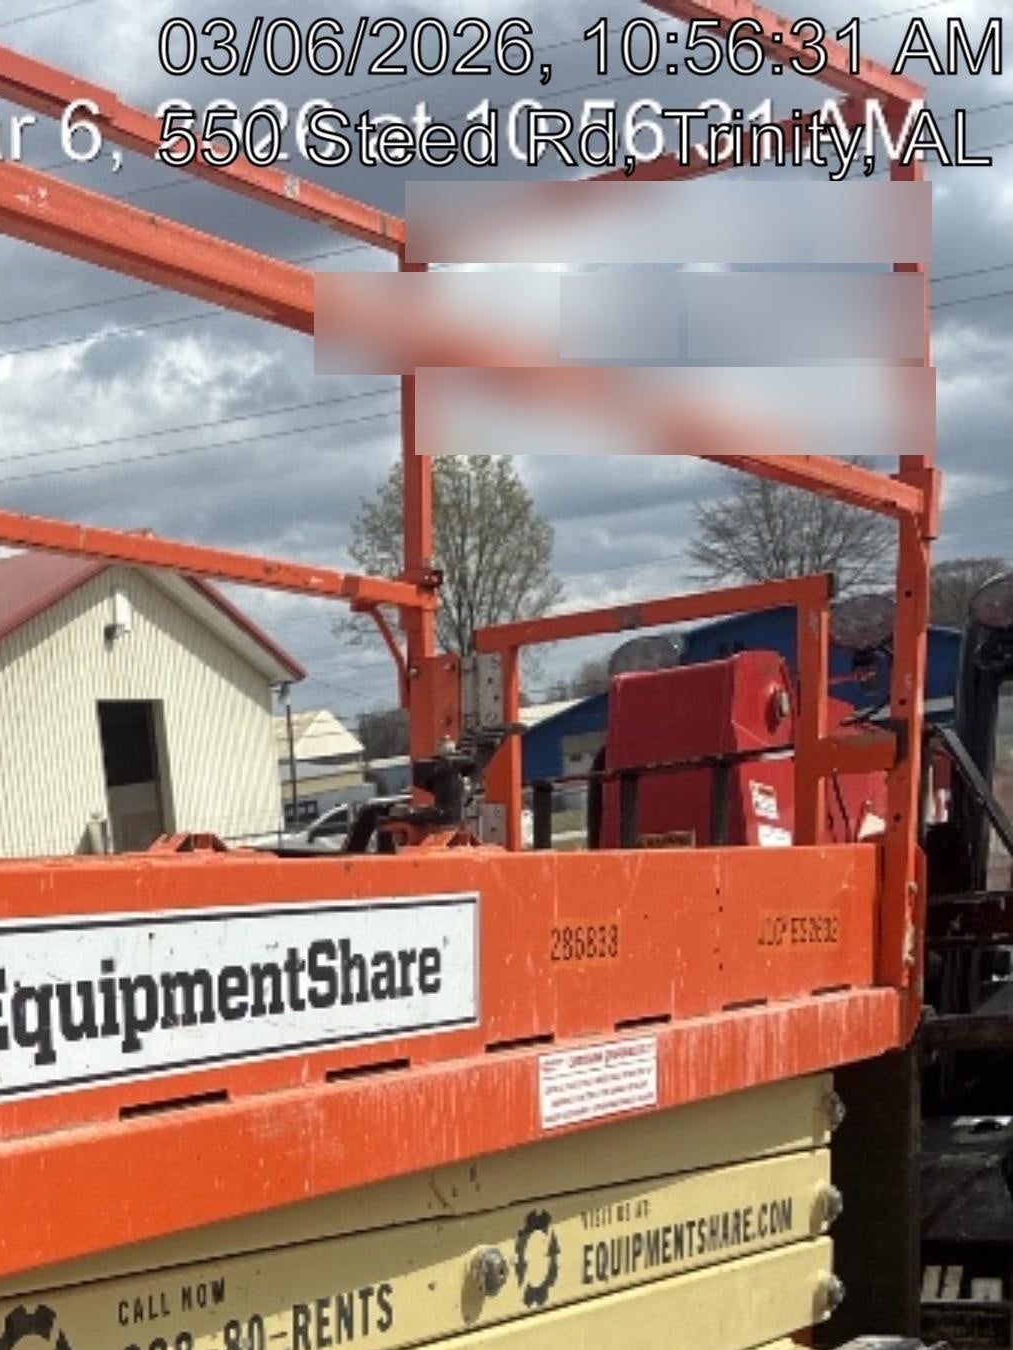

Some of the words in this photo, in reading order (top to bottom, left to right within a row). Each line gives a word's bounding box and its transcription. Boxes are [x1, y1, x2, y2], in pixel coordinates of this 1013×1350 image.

[582, 1198, 792, 1284] EQUIPMENTSHARE.COM
[118, 1291, 171, 1327] CALL
[180, 1277, 226, 1313] NOW
